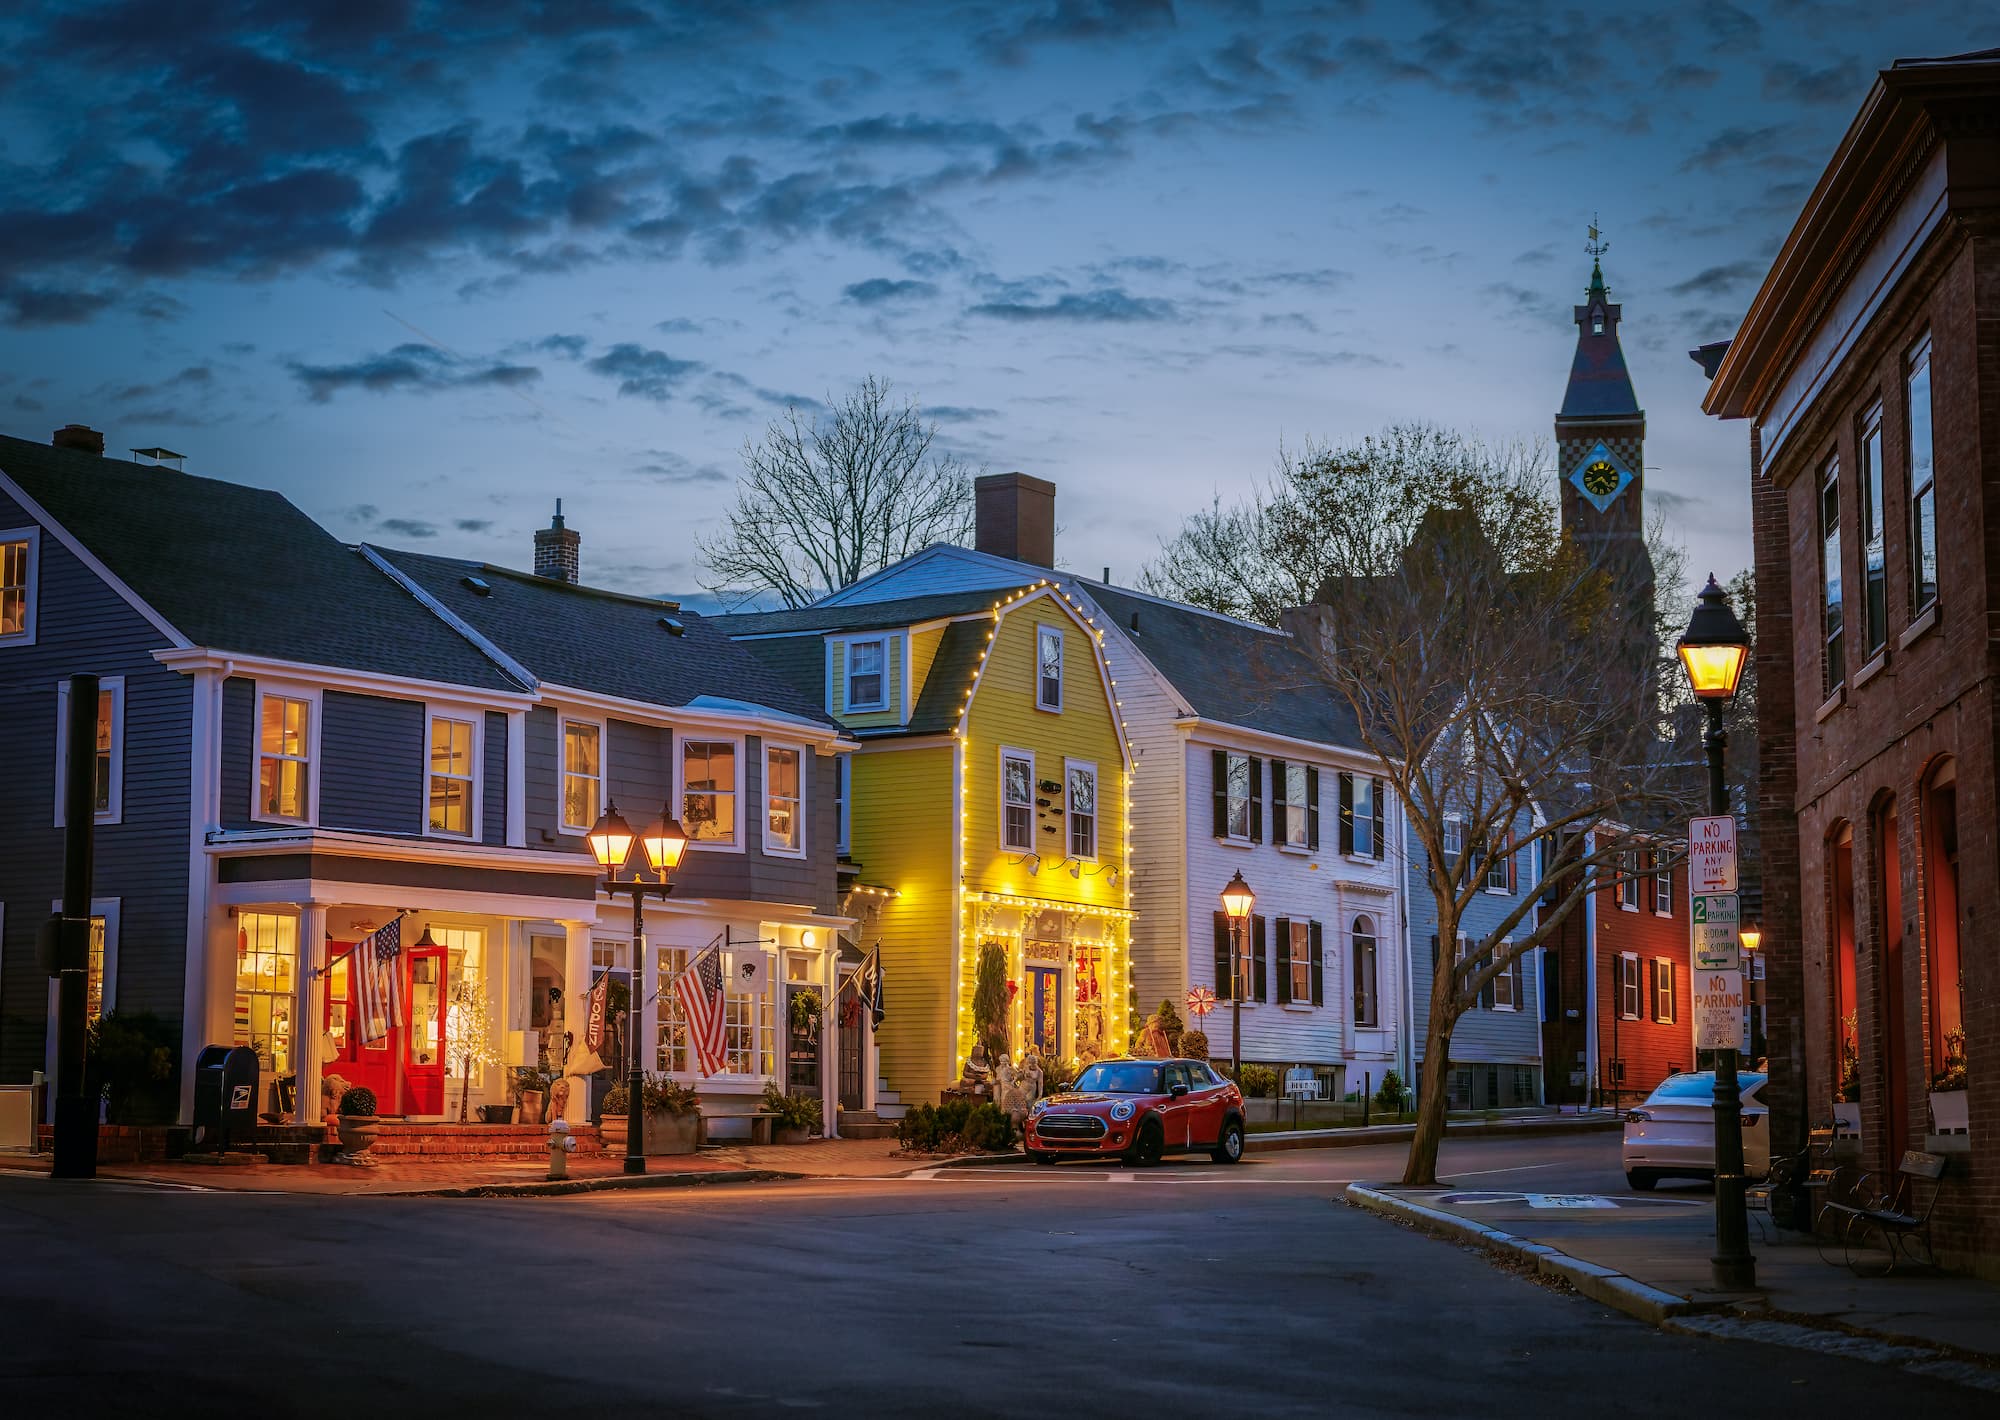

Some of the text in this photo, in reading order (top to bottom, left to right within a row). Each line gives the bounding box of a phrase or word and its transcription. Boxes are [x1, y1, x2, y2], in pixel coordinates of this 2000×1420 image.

[1704, 823, 1720, 838] NO
[1693, 839, 1733, 856] PARKING
[1704, 855, 1722, 866] ANY
[1703, 867, 1725, 878] TIME
[1695, 900, 1706, 920] 2
[1716, 898, 1727, 908] HR
[1707, 911, 1737, 921] PARKING
[1698, 942, 1707, 953] TO
[1709, 976, 1726, 992] NO
[1695, 993, 1742, 1008] PARKING
[589, 1002, 601, 1046] OPEN
